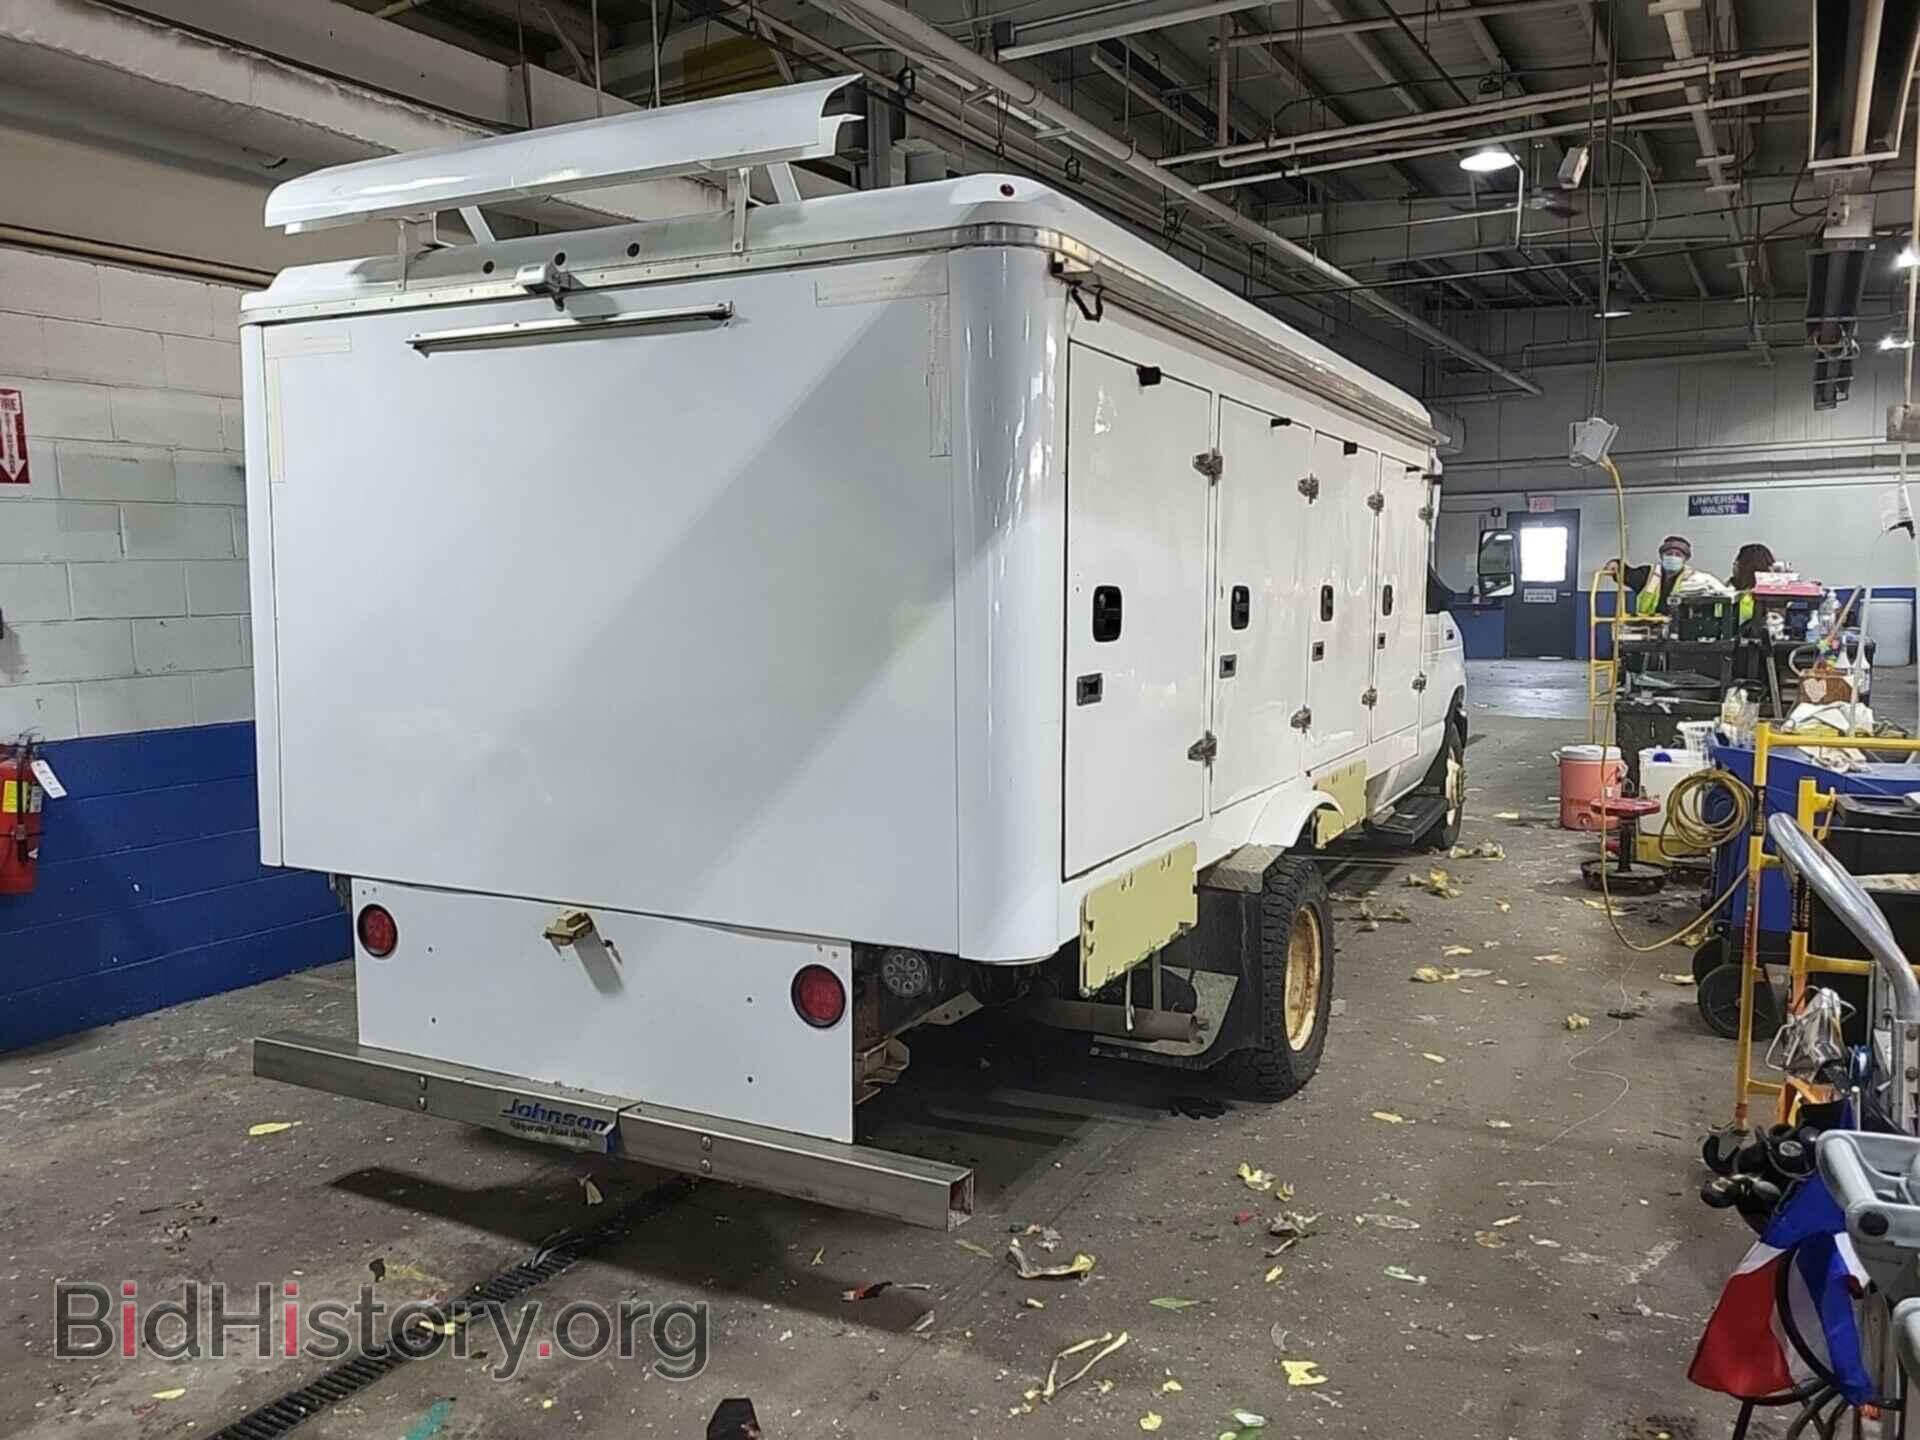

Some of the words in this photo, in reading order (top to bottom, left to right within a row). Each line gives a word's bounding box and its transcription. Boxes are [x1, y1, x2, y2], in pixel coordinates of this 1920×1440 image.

[1691, 494, 1748, 506] UNIVERSAL
[1700, 504, 1738, 514] WASTE
[501, 1098, 611, 1133] Johnson
